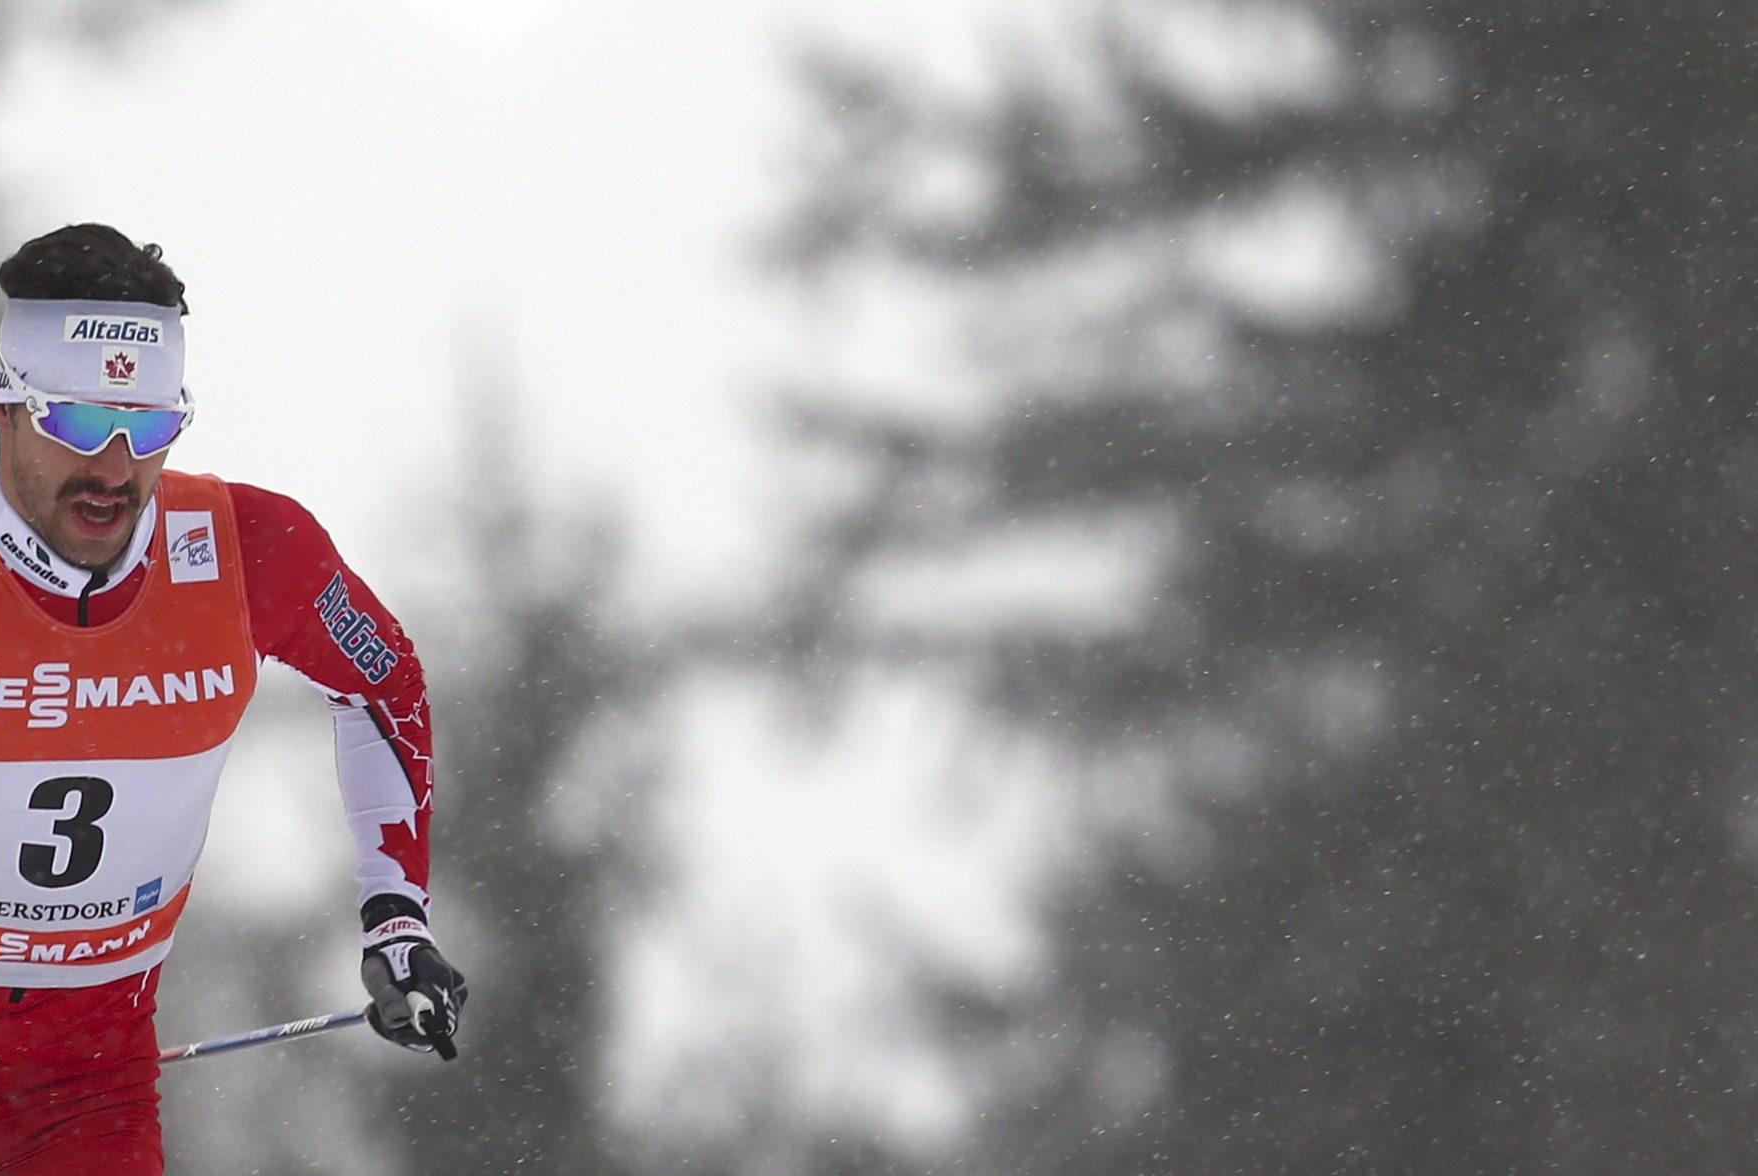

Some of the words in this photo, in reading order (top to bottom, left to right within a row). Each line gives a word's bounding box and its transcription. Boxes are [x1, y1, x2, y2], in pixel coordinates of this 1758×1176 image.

[70, 318, 160, 344] AltaGas
[0, 532, 70, 591] Cascades
[314, 570, 398, 685] AltaGas
[17, 775, 115, 889] 3
